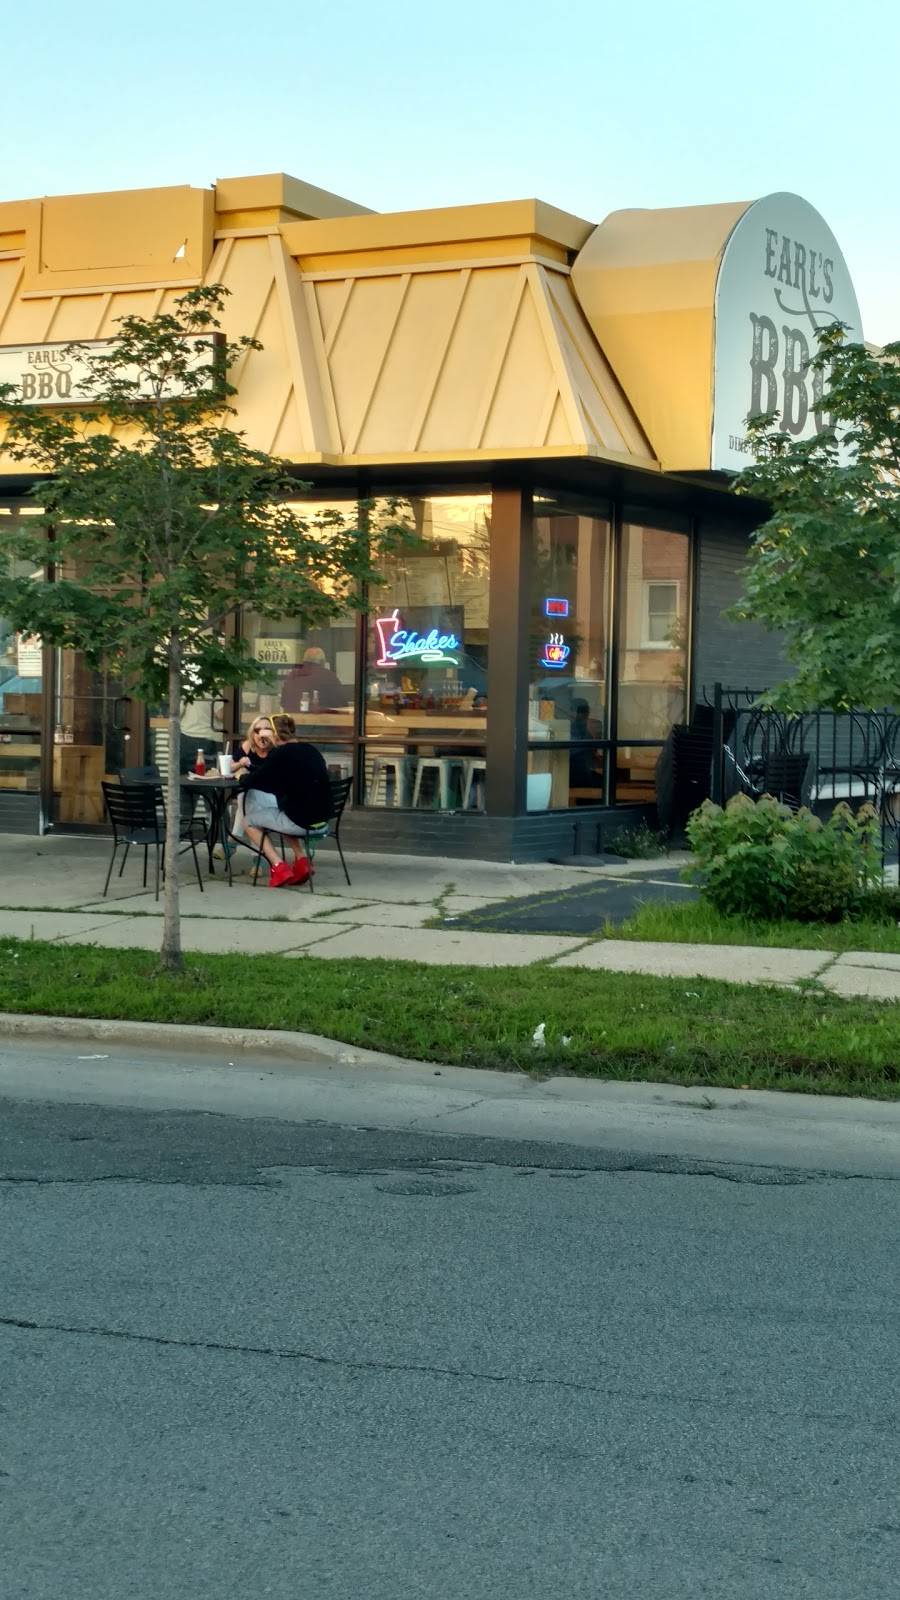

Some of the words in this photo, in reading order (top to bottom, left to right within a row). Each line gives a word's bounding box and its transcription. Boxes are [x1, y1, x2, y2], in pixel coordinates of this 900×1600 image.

[763, 227, 834, 304] EARL'S
[27, 351, 66, 364] EARL'S
[21, 372, 72, 399] BBQ
[257, 650, 288, 662] SODA
[386, 629, 458, 657] Shakes
